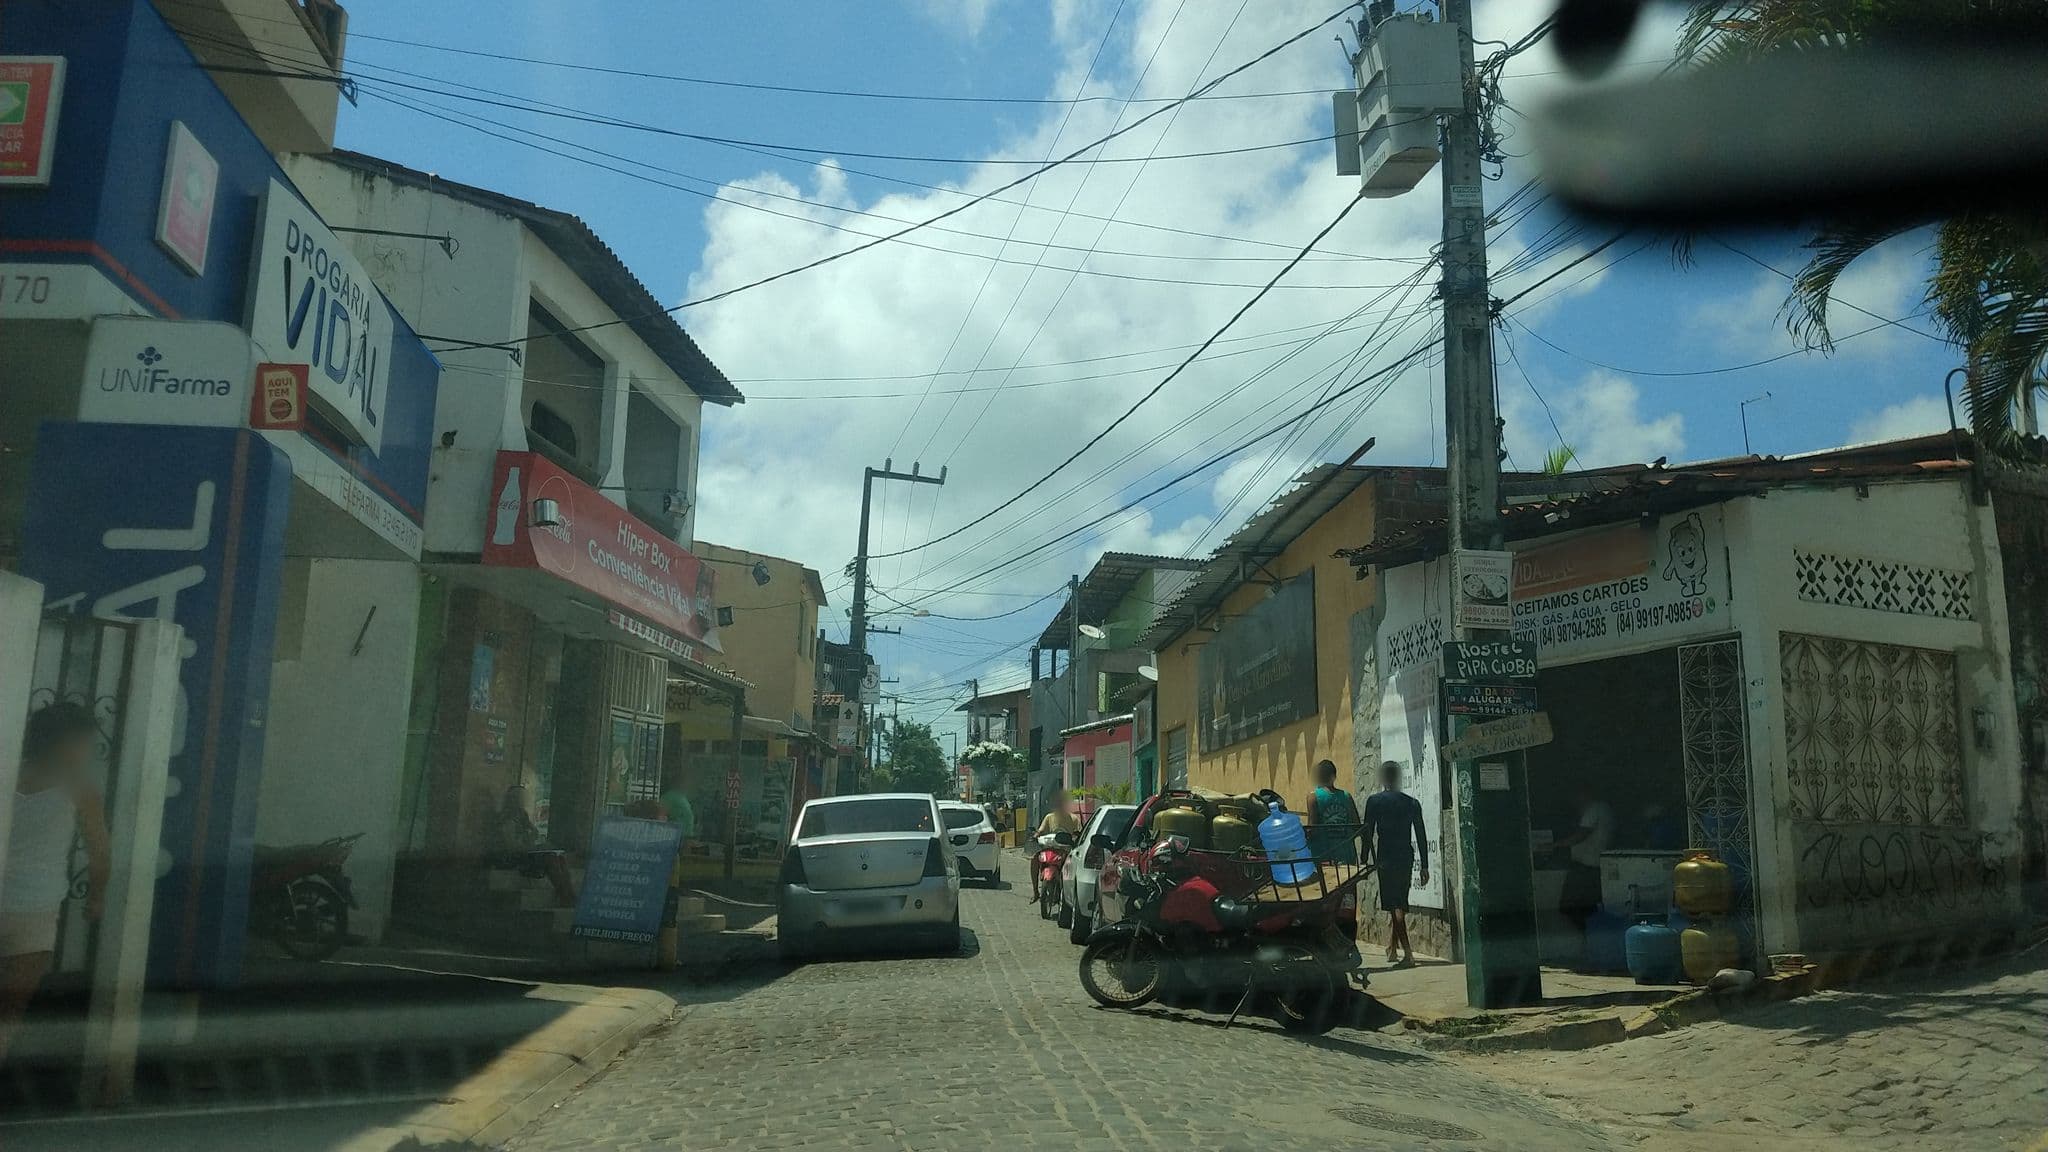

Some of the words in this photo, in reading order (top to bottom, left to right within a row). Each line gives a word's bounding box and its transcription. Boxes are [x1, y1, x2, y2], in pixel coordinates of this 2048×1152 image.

[286, 218, 370, 331] DROGARIA
[283, 255, 377, 428] VIDAL
[267, 377, 293, 387] AQUI
[268, 388, 290, 398] TEM
[617, 519, 650, 559] Hiper
[651, 542, 671, 575] Box
[588, 538, 666, 602] Conveniência
[666, 583, 691, 617] Vidal
[1582, 577, 1649, 603] CARTÕES
[1610, 597, 1641, 614] GELO
[1539, 627, 1555, 650] (84)
[1556, 616, 1607, 642] 98794-2585
[1616, 613, 1635, 639] (84)
[1636, 600, 1692, 630] 99197-0985
[574, 927, 582, 937] O
[583, 928, 621, 940] MELHOR
[621, 931, 655, 944] PREÇO!
